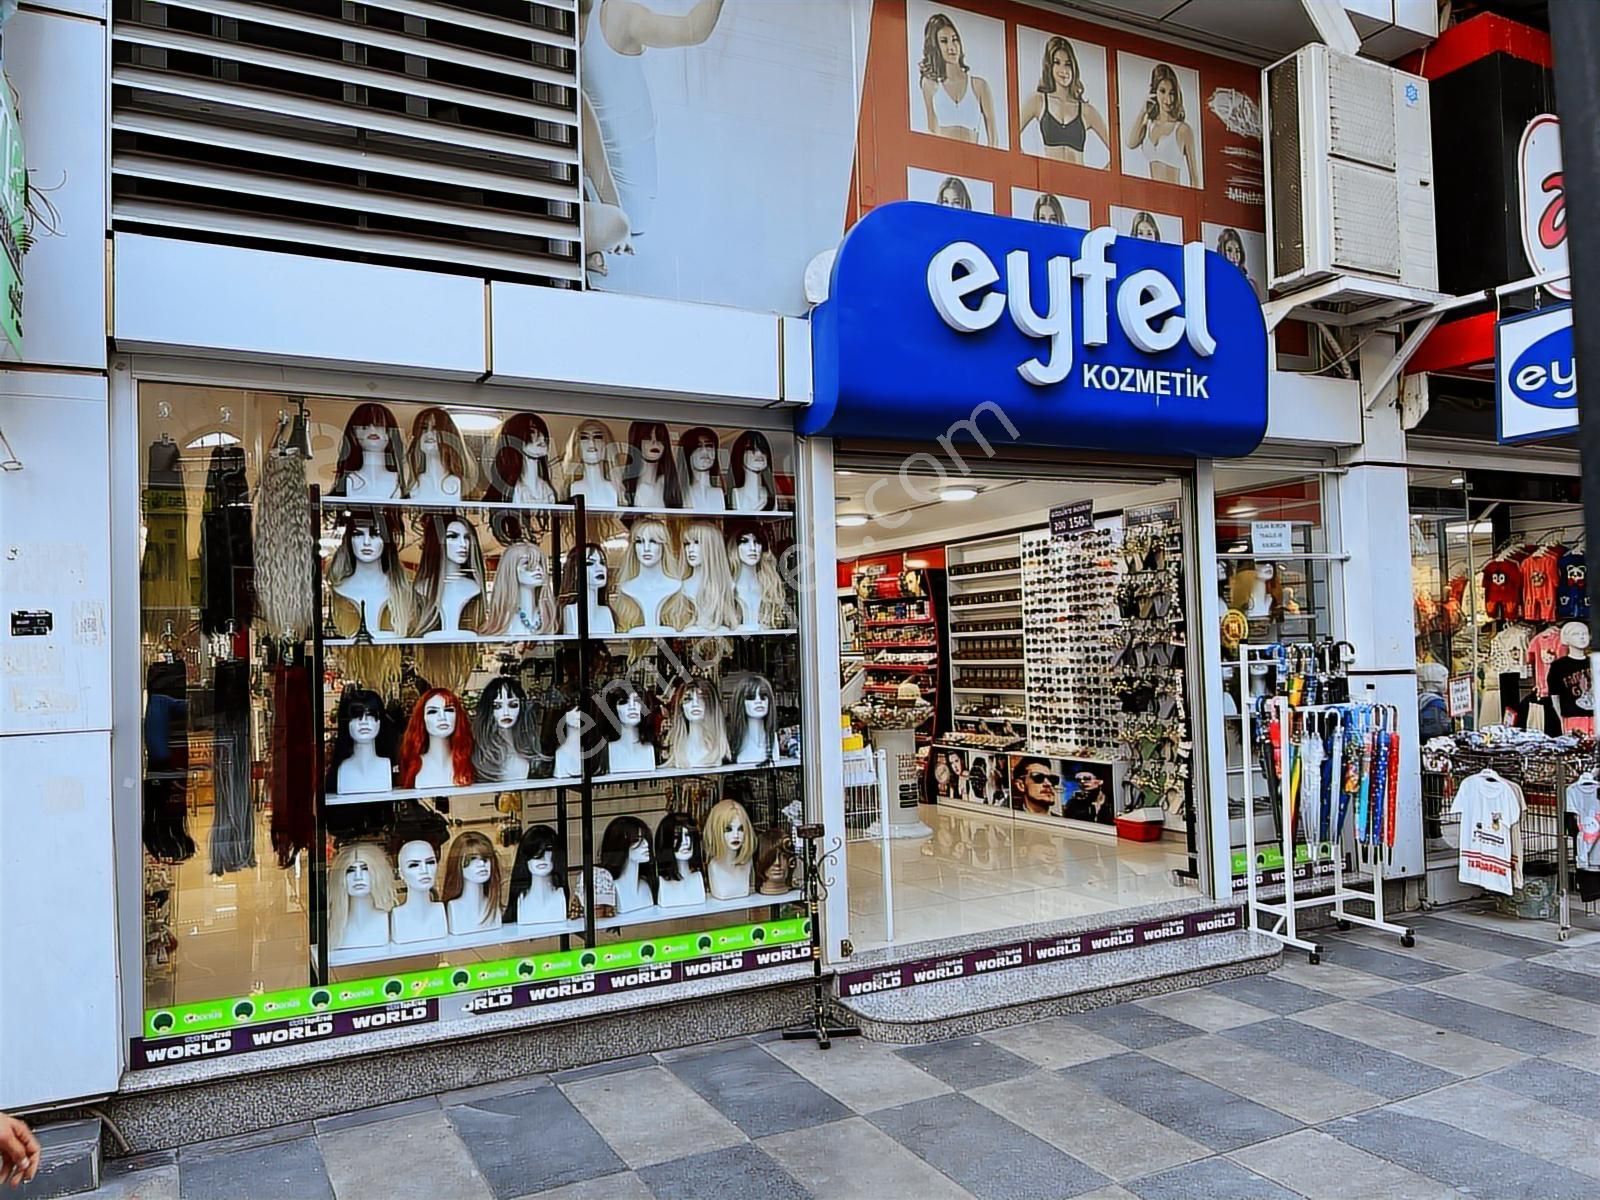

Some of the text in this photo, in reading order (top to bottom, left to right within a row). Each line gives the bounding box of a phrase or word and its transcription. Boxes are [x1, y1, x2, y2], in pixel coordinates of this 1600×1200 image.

[927, 226, 1216, 385] eyfel
[1083, 364, 1209, 398] KOZMETİK
[913, 965, 963, 983] WORLD
[975, 954, 1022, 971] WORLD
[1036, 943, 1081, 959] WORLD
[1091, 933, 1134, 949] WORLD
[1143, 926, 1184, 940] WORLD
[1197, 917, 1235, 931] WORLD
[146, 1038, 231, 1062] WORLD
[252, 1022, 333, 1045] WORLD
[352, 1006, 427, 1028] WORLD
[529, 981, 595, 1001] WORLD
[611, 969, 672, 988] WORLD
[685, 958, 743, 976] WORLD
[757, 946, 811, 964] WORLD
